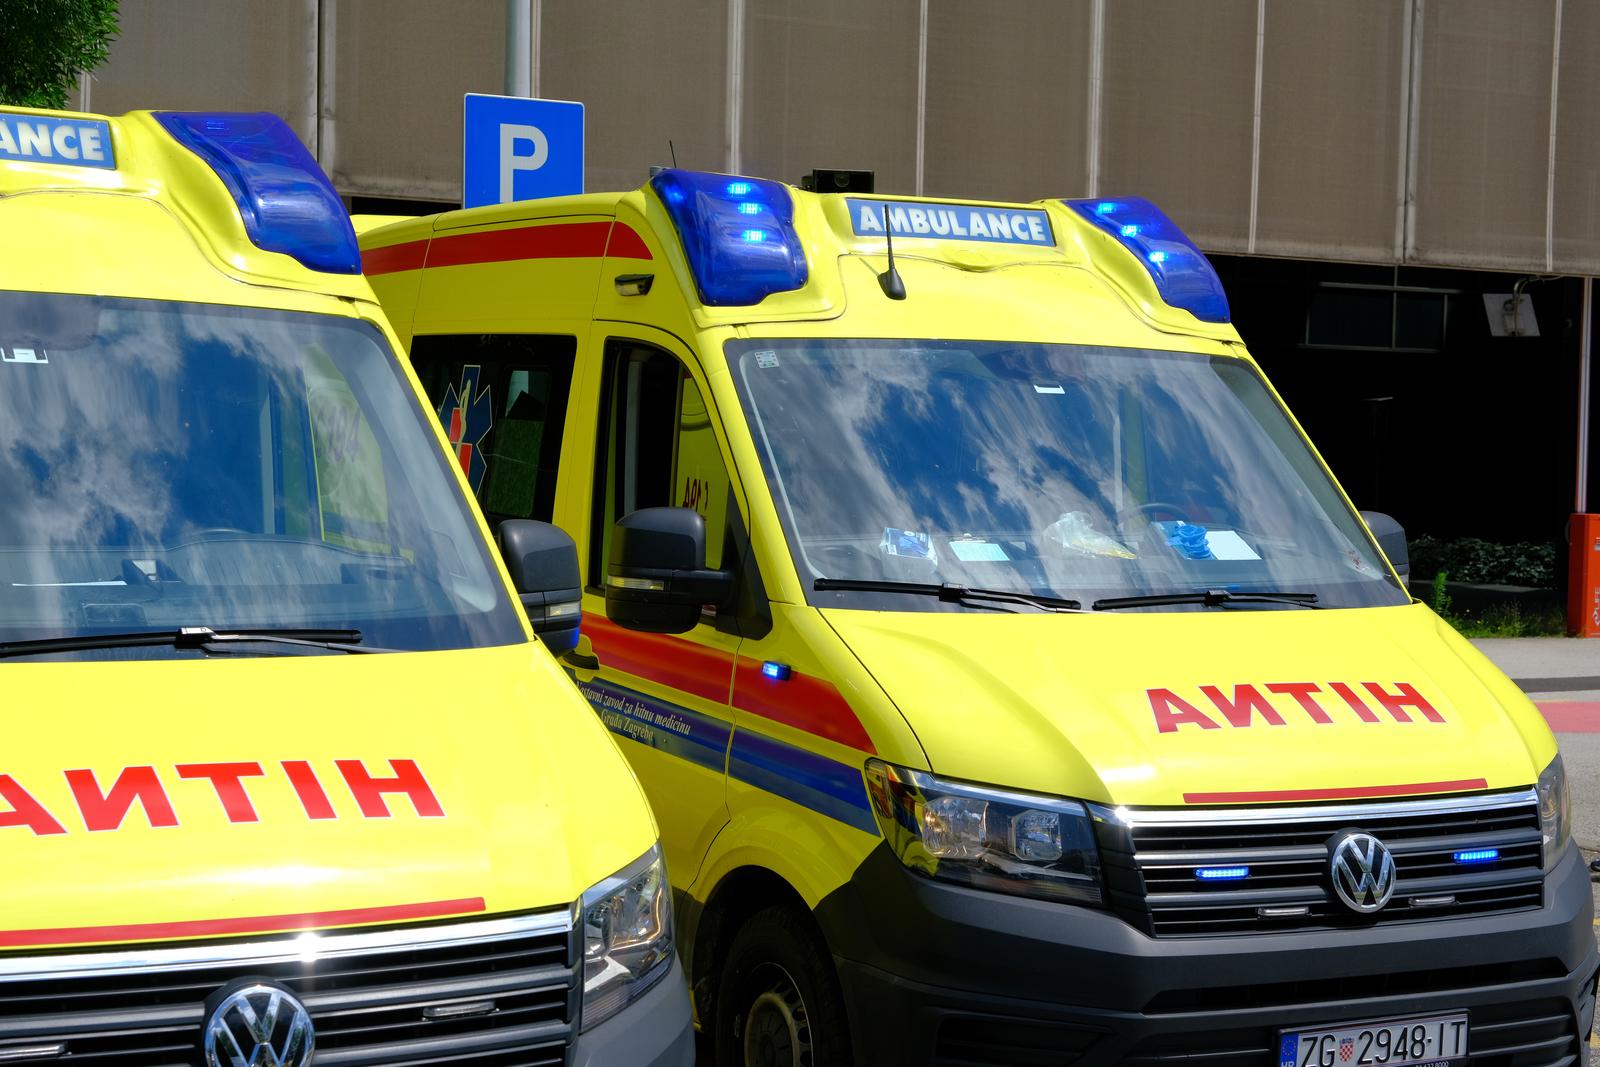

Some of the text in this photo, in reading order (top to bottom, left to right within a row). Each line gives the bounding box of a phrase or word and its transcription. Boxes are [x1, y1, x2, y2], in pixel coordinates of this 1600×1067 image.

[500, 123, 548, 203] P
[860, 205, 1046, 241] AMBULANCE
[601, 709, 654, 741] Grada Zagreba
[604, 695, 625, 711] zavod
[624, 701, 634, 715] za
[634, 702, 655, 722] hitnu
[655, 713, 691, 735] medicinu
[1332, 834, 1396, 913] VW
[1301, 1034, 1336, 1067] ZG
